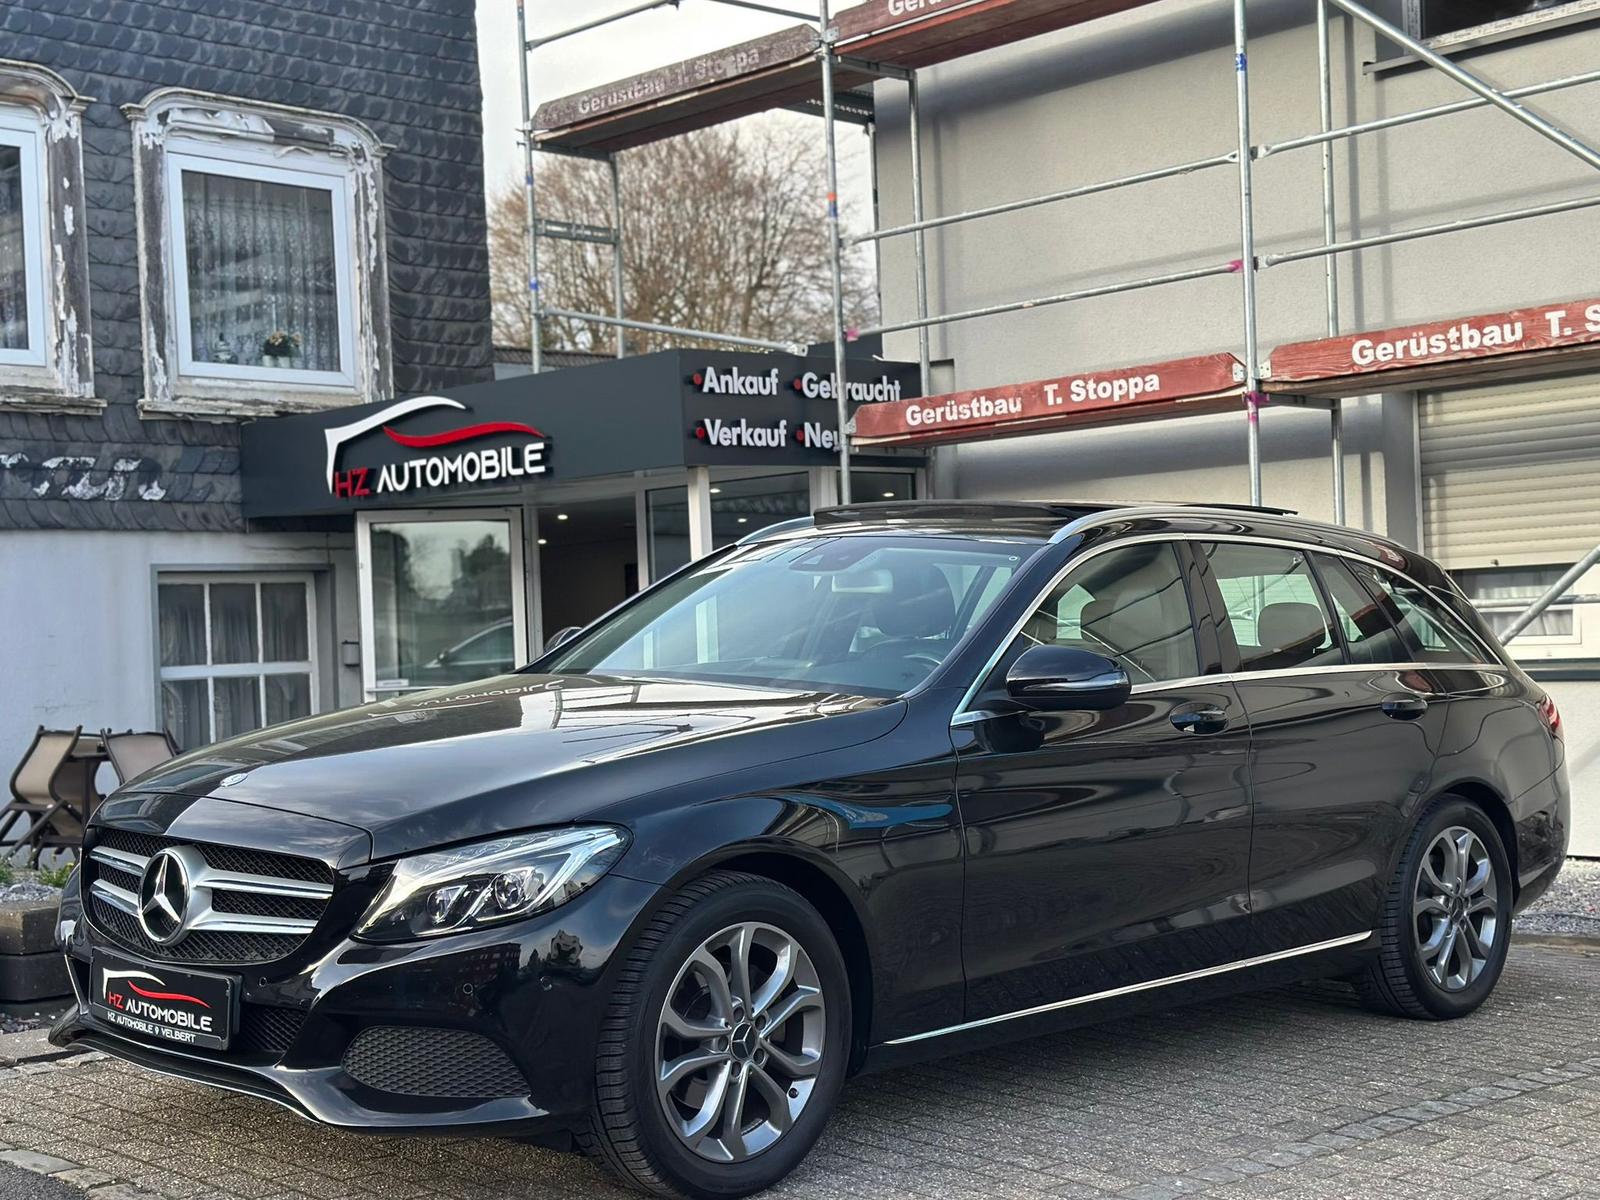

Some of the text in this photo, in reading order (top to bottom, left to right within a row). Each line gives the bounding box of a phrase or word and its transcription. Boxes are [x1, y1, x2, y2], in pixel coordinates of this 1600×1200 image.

[1351, 320, 1523, 365] Gerüstbau
[1545, 310, 1573, 337] T.
[703, 366, 779, 395] Ankauf
[906, 372, 1160, 426] Gerüstbau T. Stoppa
[704, 418, 787, 447] Verkauf
[335, 442, 546, 498] HZ AUTOMOBILE
[107, 1011, 197, 1043] HZ AUTOMOBILE VELBERT
[108, 992, 213, 1032] HZ AUTOMOBILE
